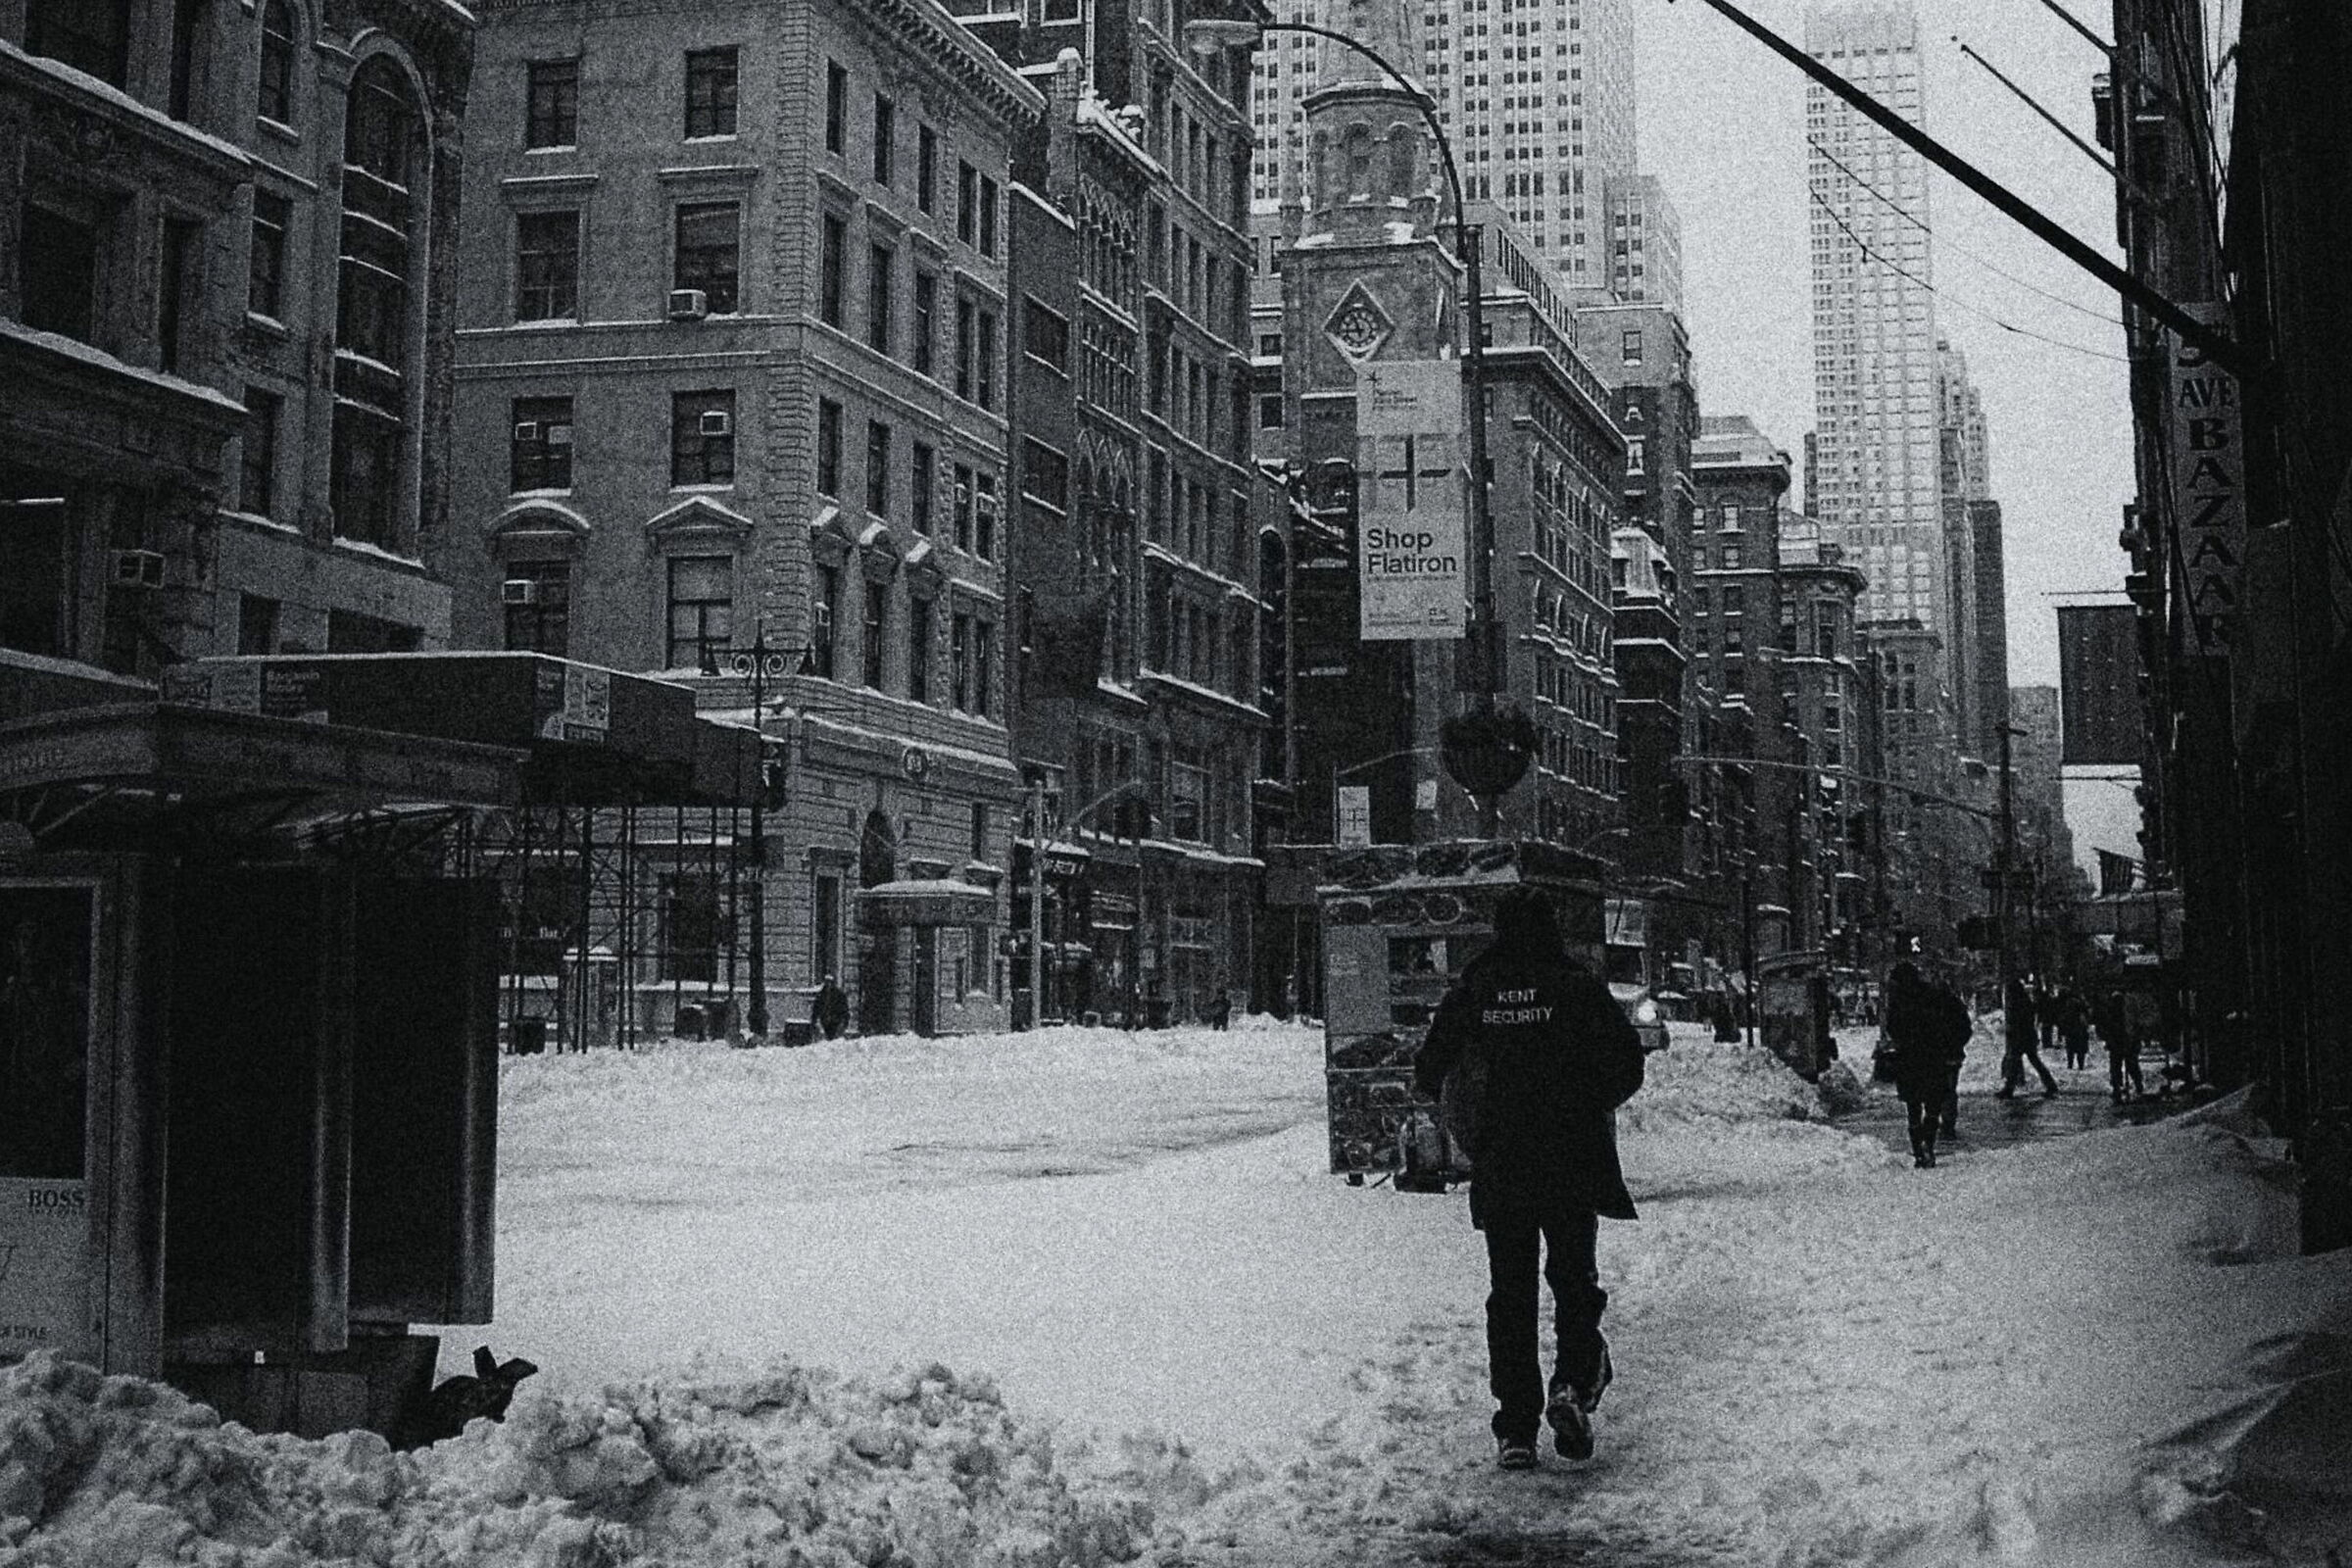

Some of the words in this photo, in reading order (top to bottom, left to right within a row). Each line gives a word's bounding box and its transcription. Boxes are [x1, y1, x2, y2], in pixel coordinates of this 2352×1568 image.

[2179, 377, 2235, 409] AVE
[1367, 527, 1434, 554] Shop
[2186, 417, 2240, 650] BAZAAR
[1367, 553, 1457, 574] Flatiron
[1496, 988, 1538, 1004] KENT
[1482, 1005, 1553, 1025] SECURITY
[28, 1189, 85, 1208] BOSS
